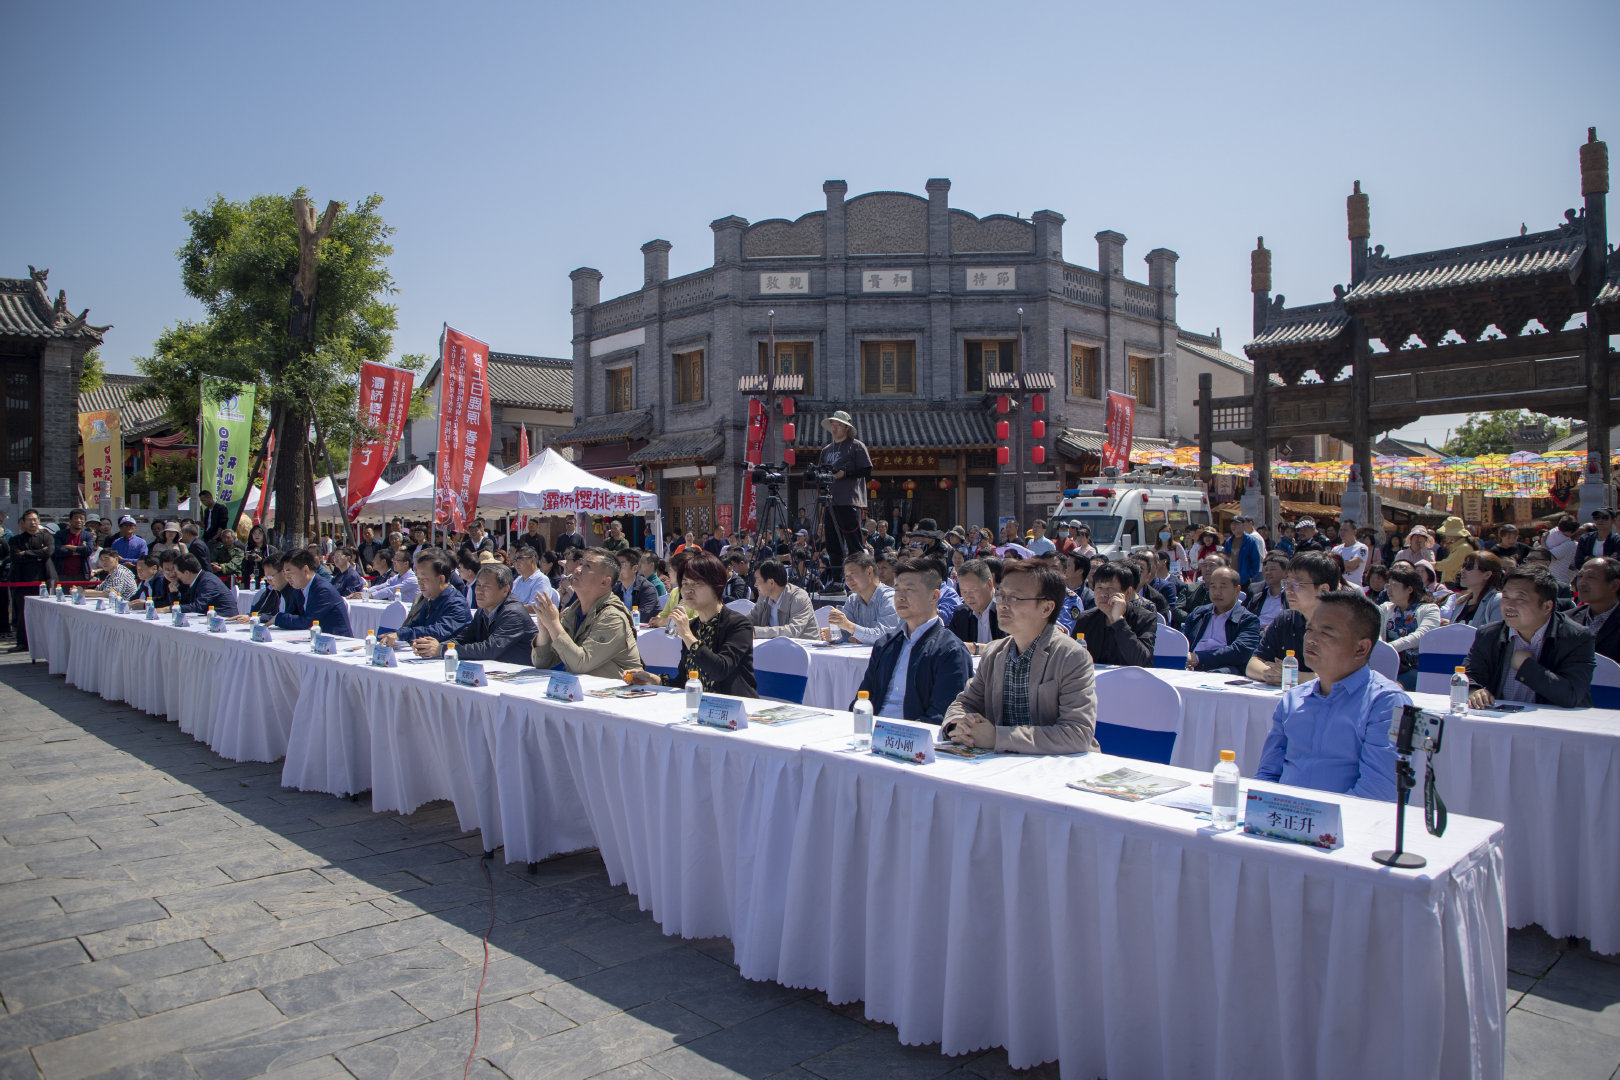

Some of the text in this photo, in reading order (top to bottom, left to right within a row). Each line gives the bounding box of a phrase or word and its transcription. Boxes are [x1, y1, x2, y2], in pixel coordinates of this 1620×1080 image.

[361, 376, 385, 466] 灞桥樱桃了
[542, 490, 640, 512] 灞桥樱桃集市
[1266, 811, 1315, 834] 李正升
